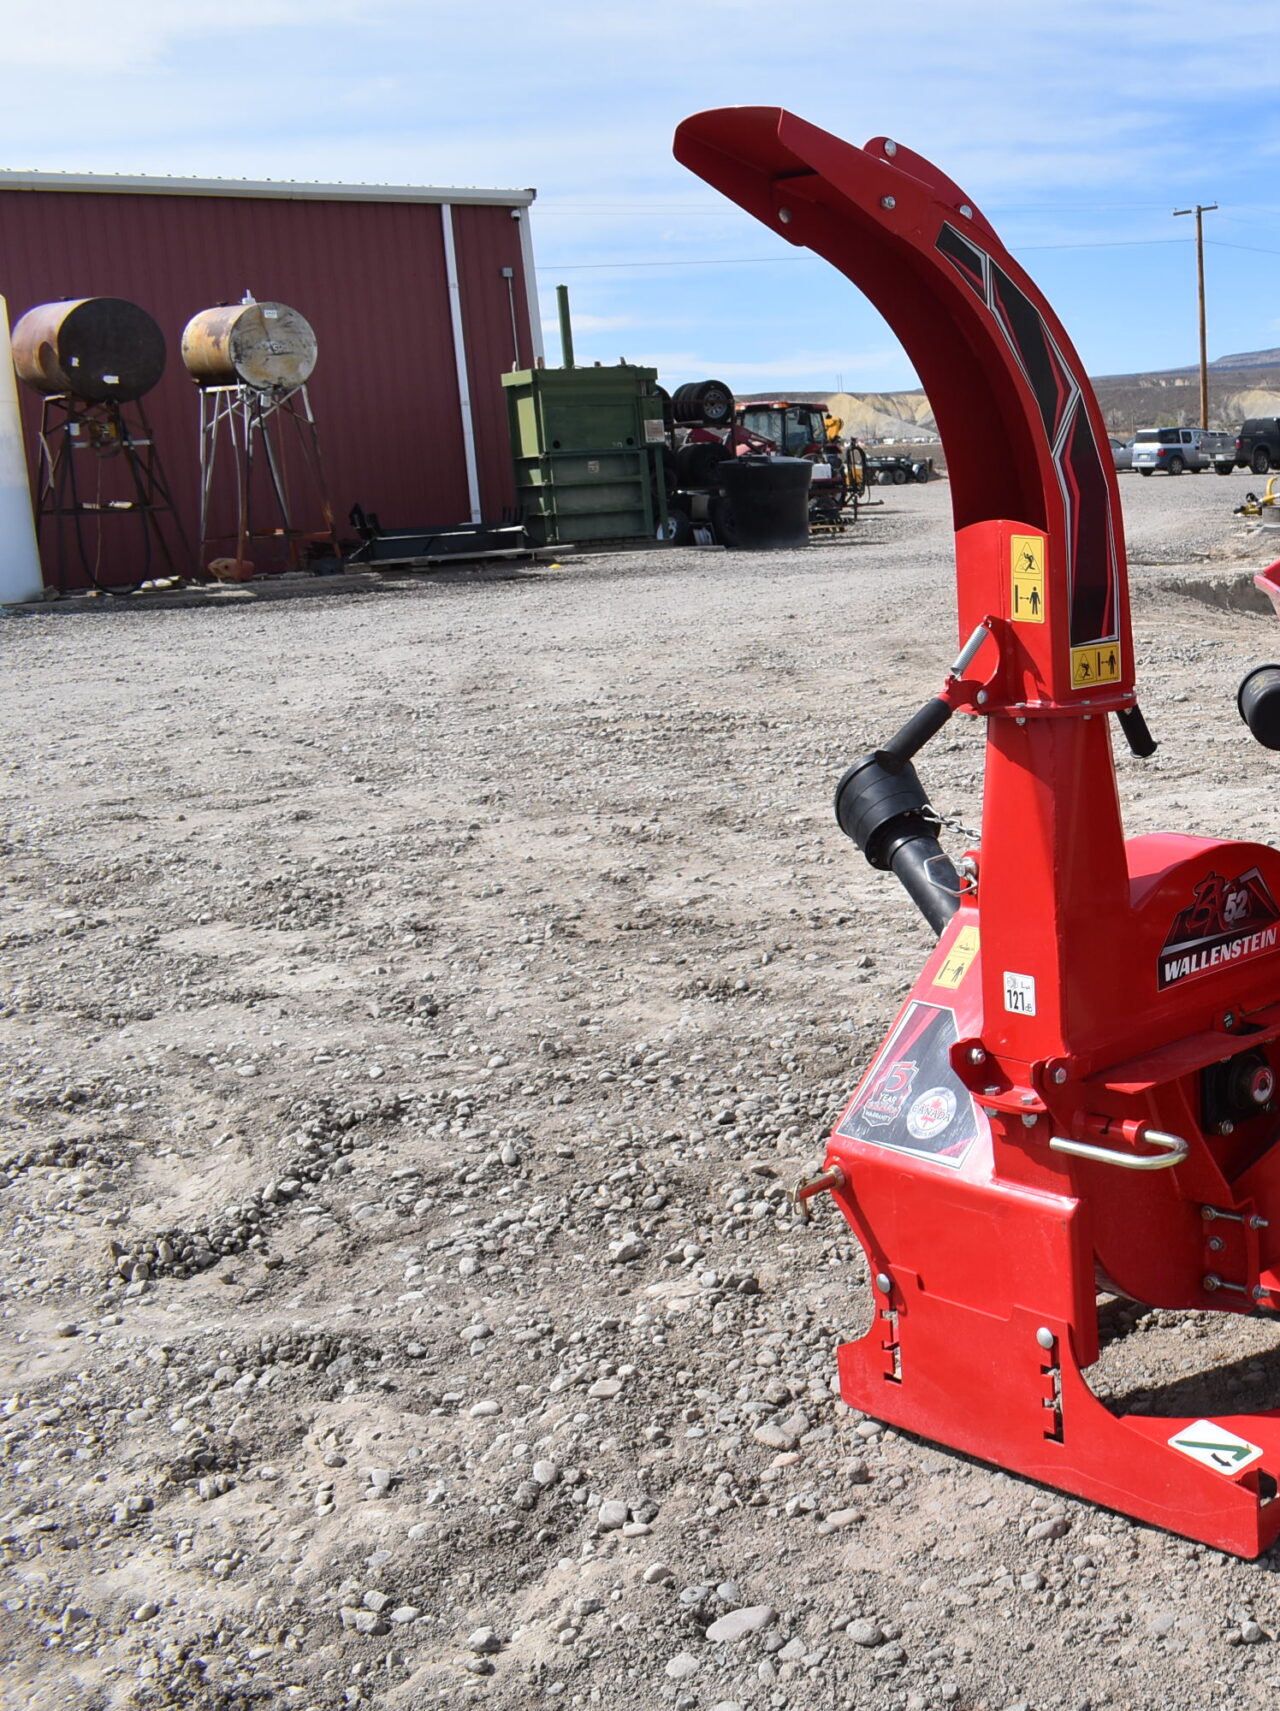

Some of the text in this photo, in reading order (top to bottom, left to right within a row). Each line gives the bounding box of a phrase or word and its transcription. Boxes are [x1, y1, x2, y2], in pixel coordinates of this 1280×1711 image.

[1164, 927, 1277, 982] WALLENSTEIN
[1007, 989, 1025, 1011] 121
[912, 1104, 951, 1122] CANADA
